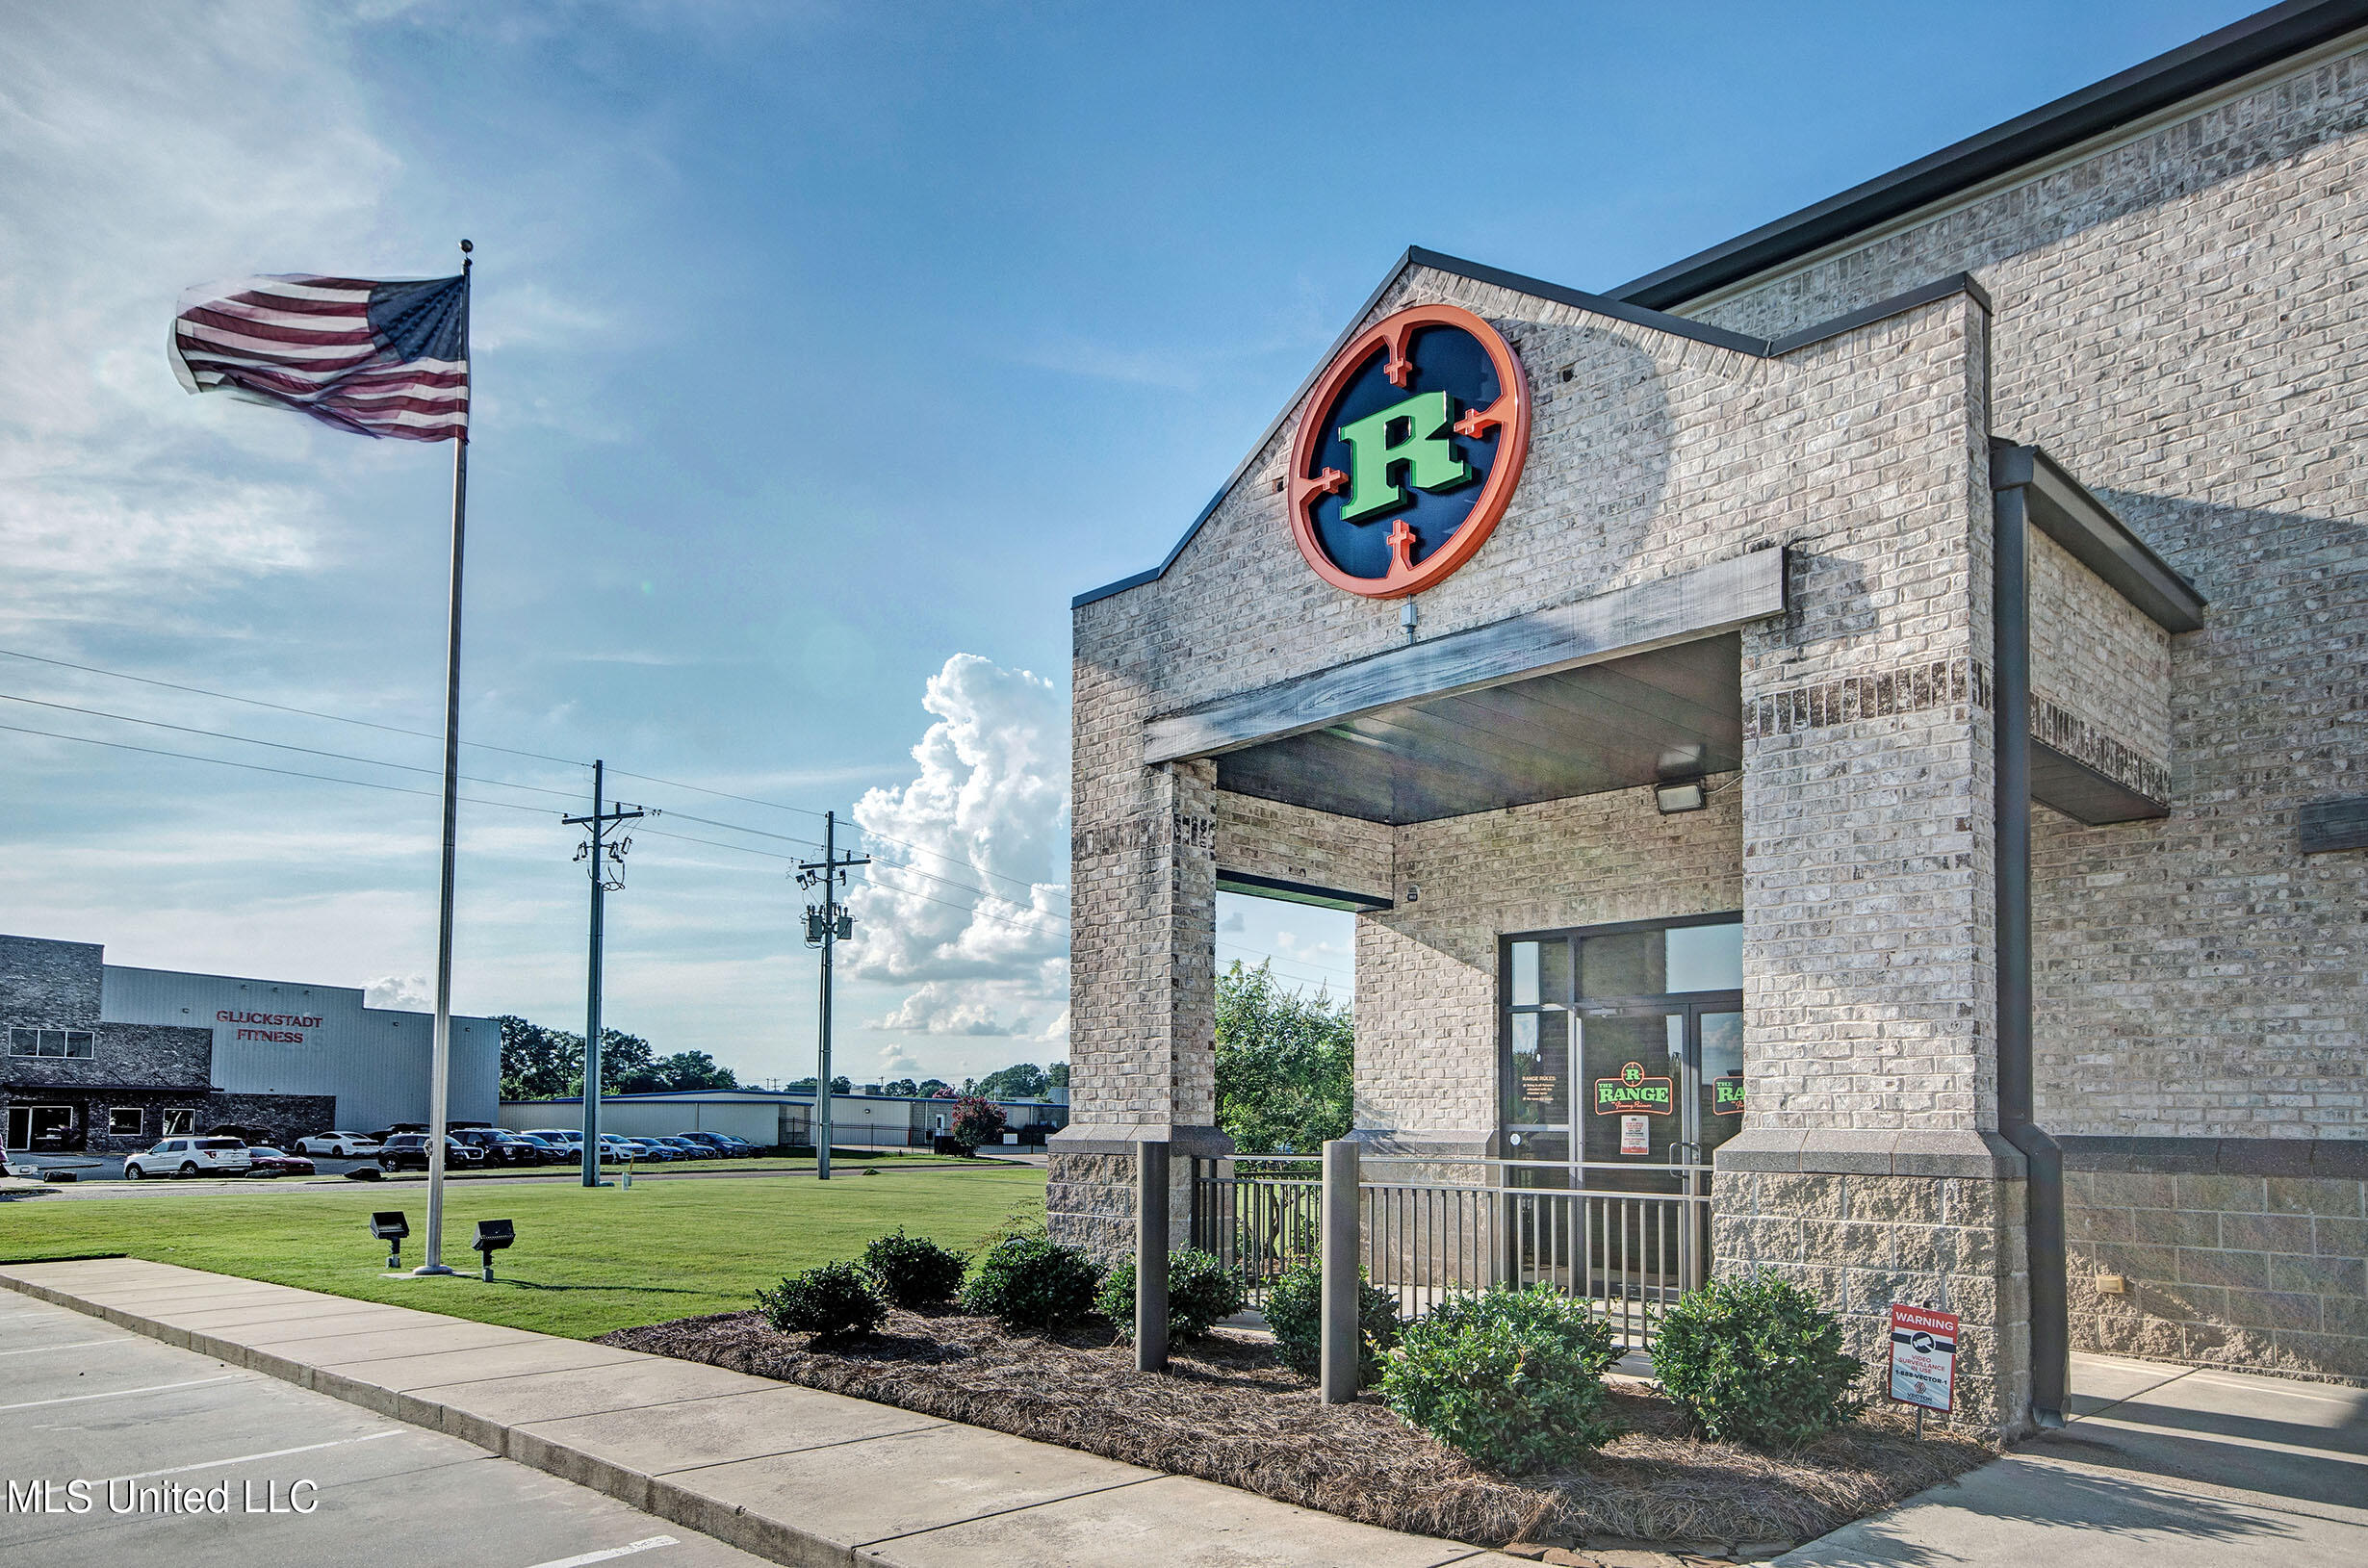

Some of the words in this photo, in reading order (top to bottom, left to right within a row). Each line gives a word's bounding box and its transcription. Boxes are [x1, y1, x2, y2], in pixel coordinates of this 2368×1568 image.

[1338, 390, 1472, 523] R
[216, 1010, 323, 1028] GLUCKSTADT
[237, 1029, 304, 1043] FITNESS
[1625, 1068, 1640, 1081] R
[1599, 1087, 1669, 1103] RANGE
[1895, 1311, 1954, 1330] WARNING
[1898, 1357, 1945, 1372] SURVEILLANCE
[1912, 1354, 1931, 1363] VIDEO
[1907, 1392, 1932, 1401] VECTOR
